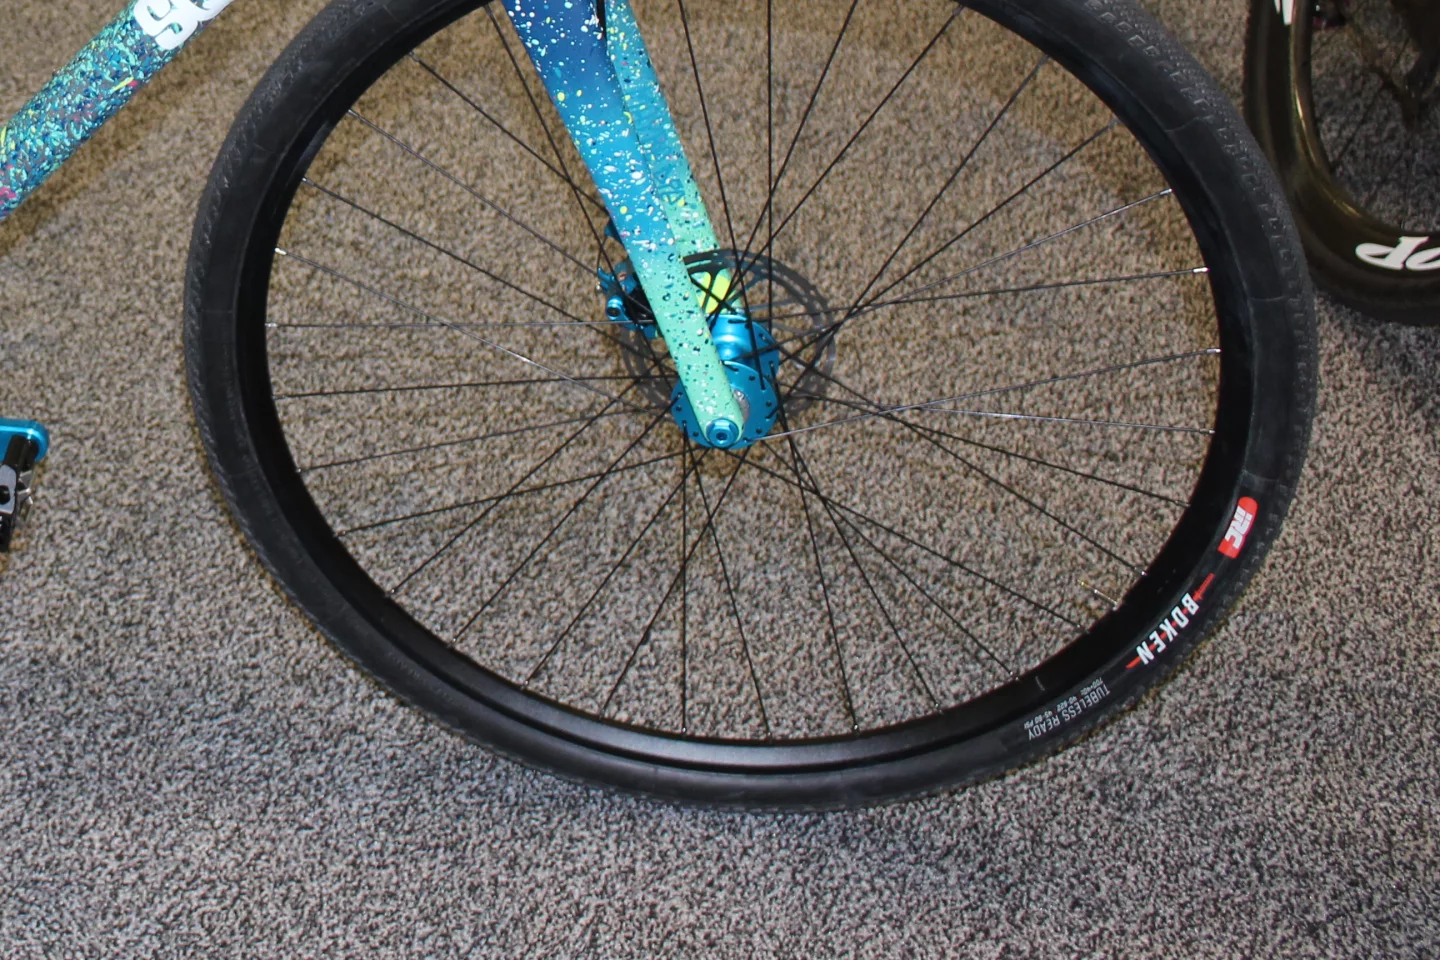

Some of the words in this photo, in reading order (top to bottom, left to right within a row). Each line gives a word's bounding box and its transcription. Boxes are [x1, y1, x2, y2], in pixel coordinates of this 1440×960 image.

[1135, 592, 1200, 665] BOKEN
[1061, 683, 1110, 722] TUBELESS
[1028, 715, 1060, 741] READY
